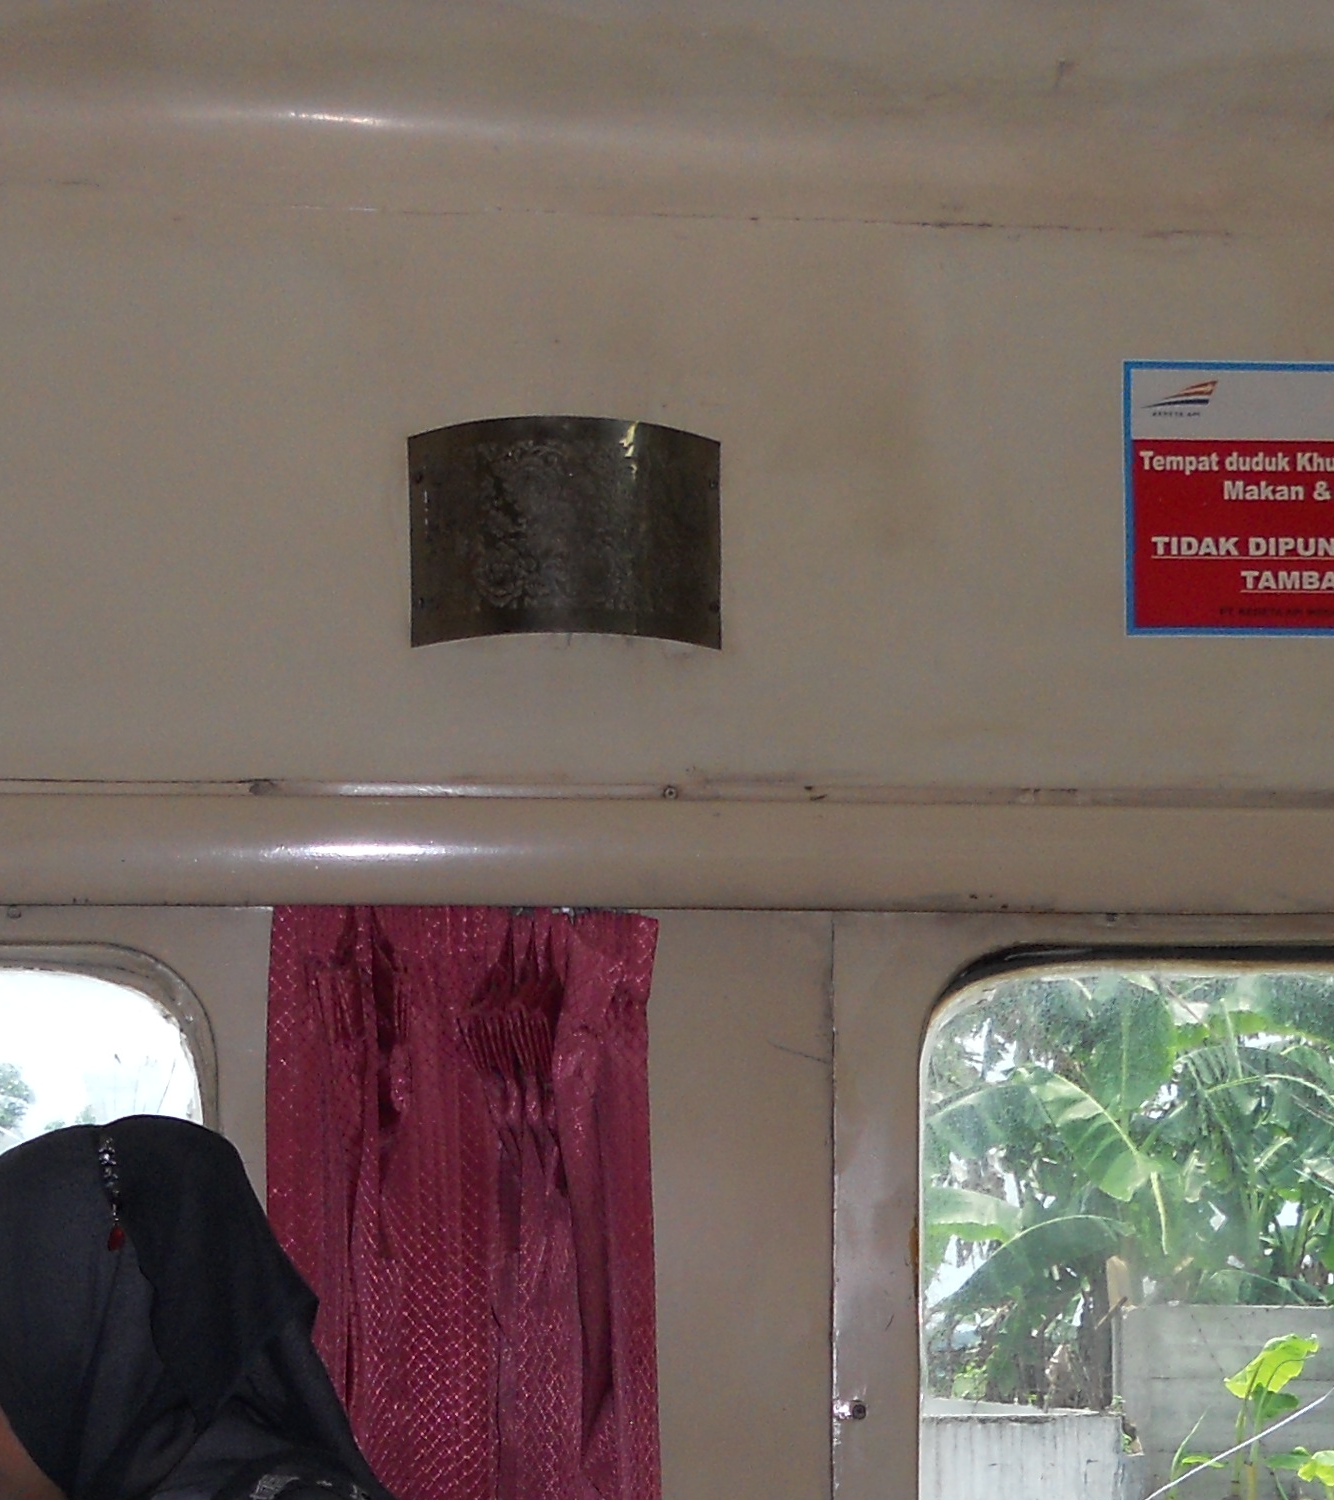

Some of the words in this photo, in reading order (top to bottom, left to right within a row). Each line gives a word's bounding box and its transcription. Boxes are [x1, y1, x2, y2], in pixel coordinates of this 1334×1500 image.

[1140, 450, 1219, 476] Tempat
[1225, 452, 1290, 472] duduk
[1223, 481, 1305, 501] Makan
[1313, 480, 1331, 501] &
[1152, 536, 1239, 556] TIDAK
